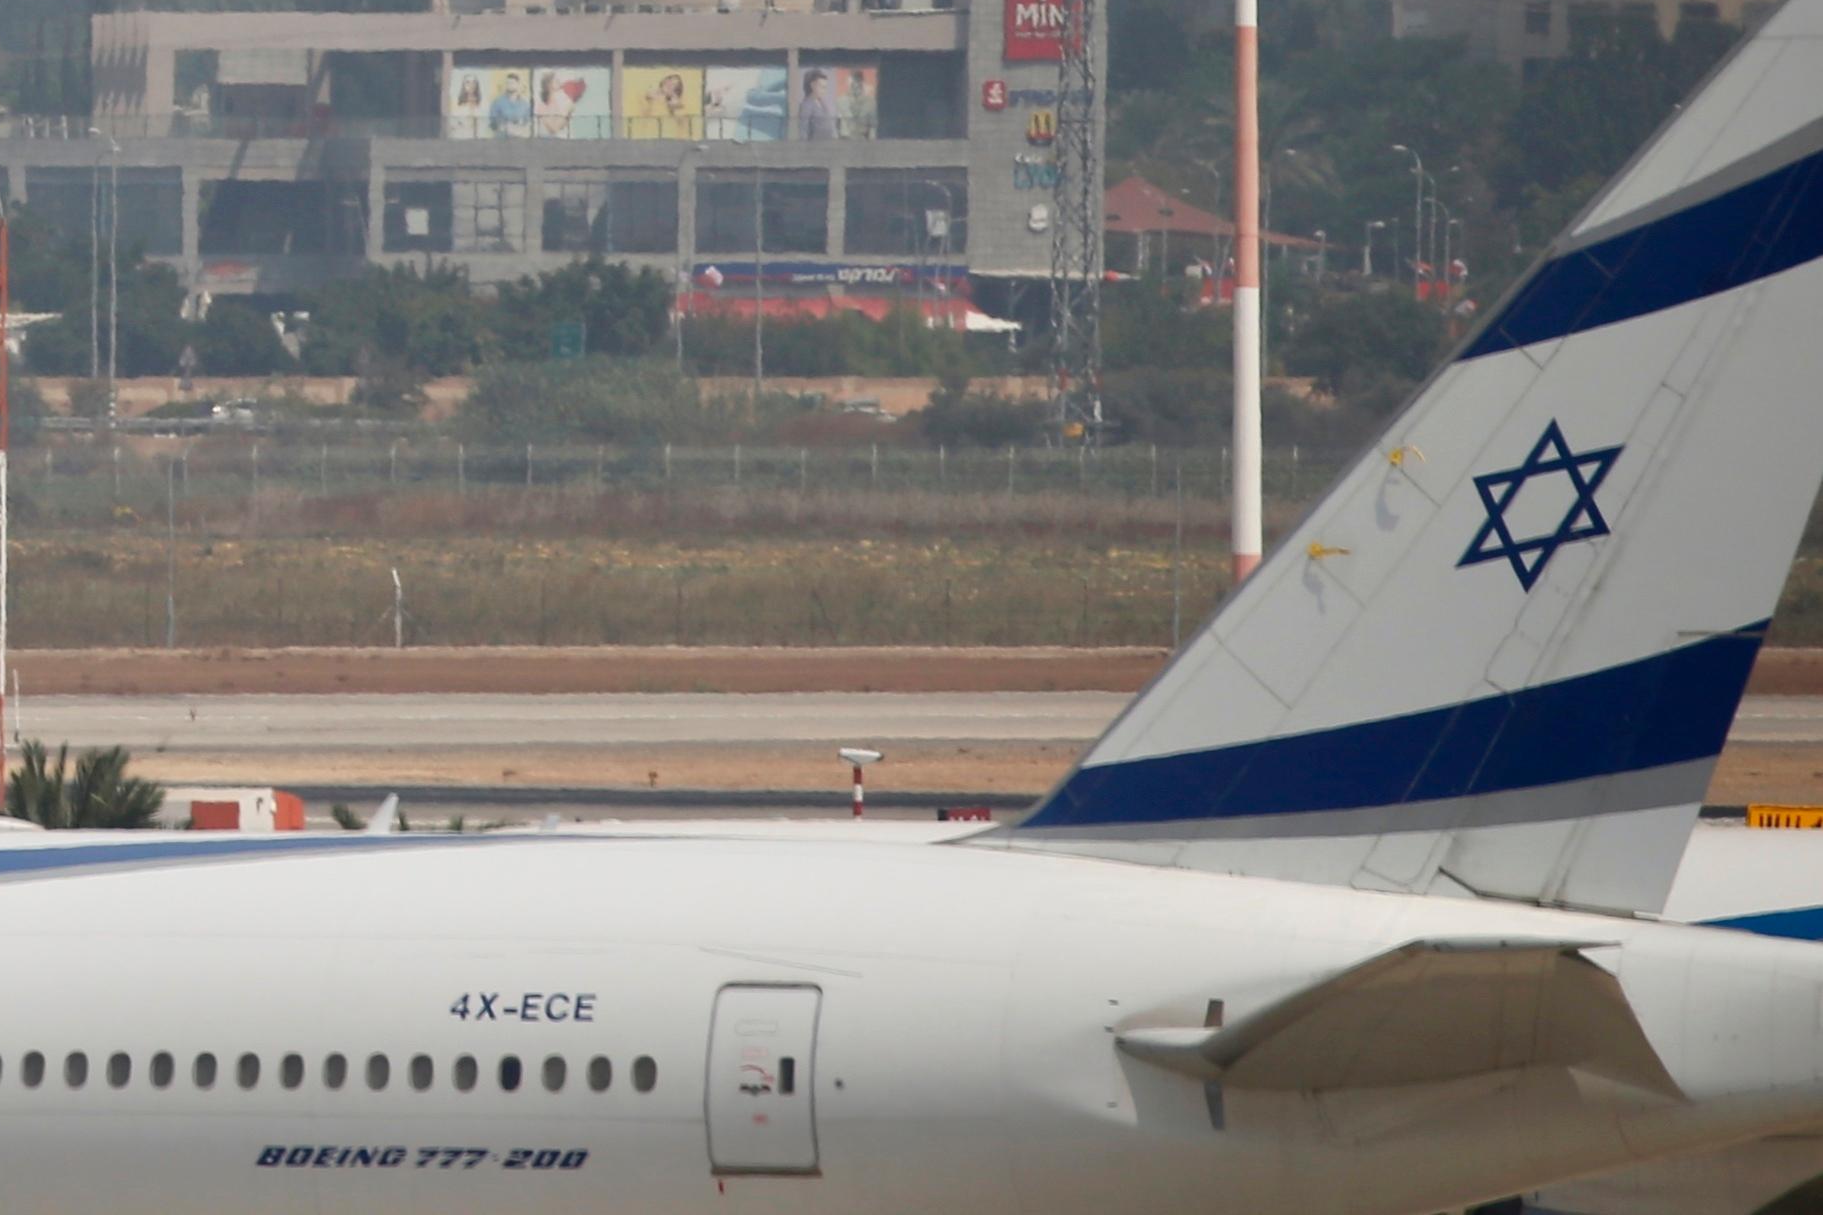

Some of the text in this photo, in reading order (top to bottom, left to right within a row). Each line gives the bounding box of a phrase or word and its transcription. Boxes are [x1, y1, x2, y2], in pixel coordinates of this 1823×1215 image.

[449, 992, 597, 1022] 4X-ECE
[256, 1145, 589, 1169] BOEING 777-200
